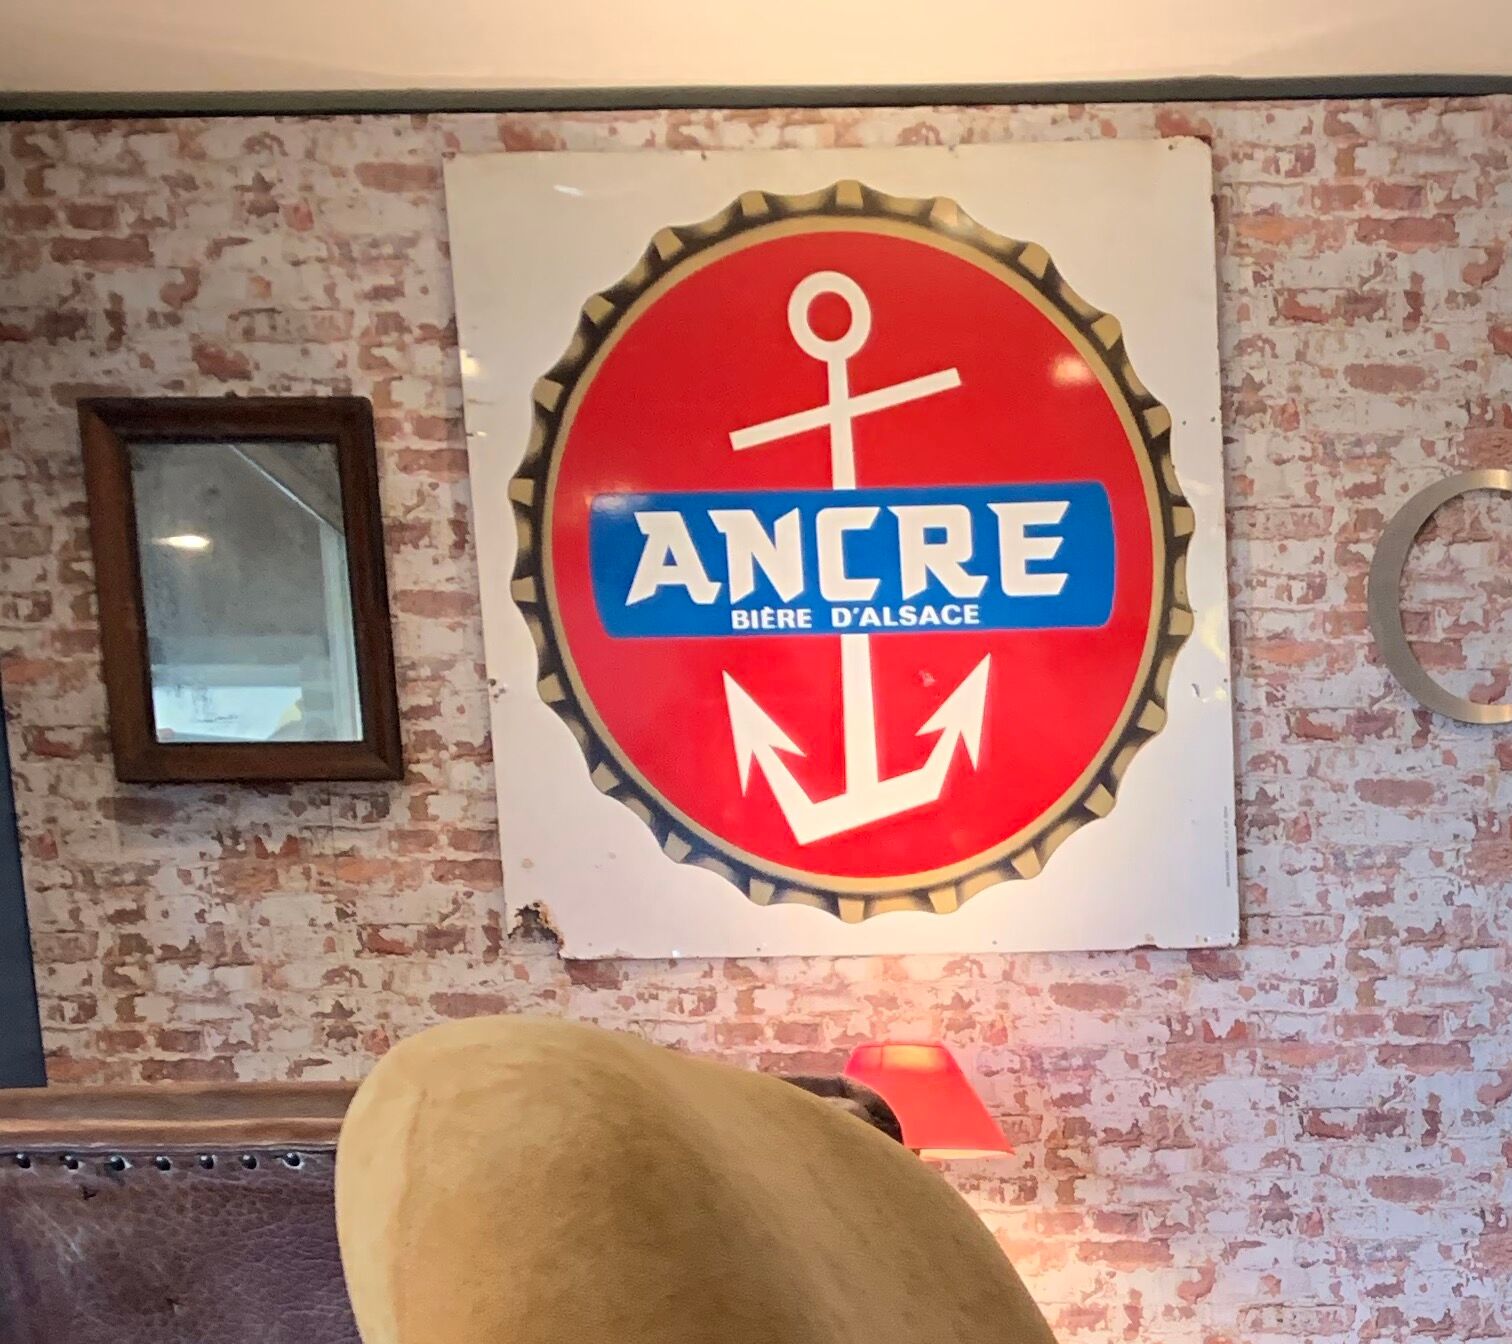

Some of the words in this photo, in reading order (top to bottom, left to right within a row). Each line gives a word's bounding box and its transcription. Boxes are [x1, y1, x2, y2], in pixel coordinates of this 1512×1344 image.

[625, 500, 1070, 606] ANCRE
[730, 607, 813, 630] BIÈRE
[831, 604, 981, 628] D'ALSACE
